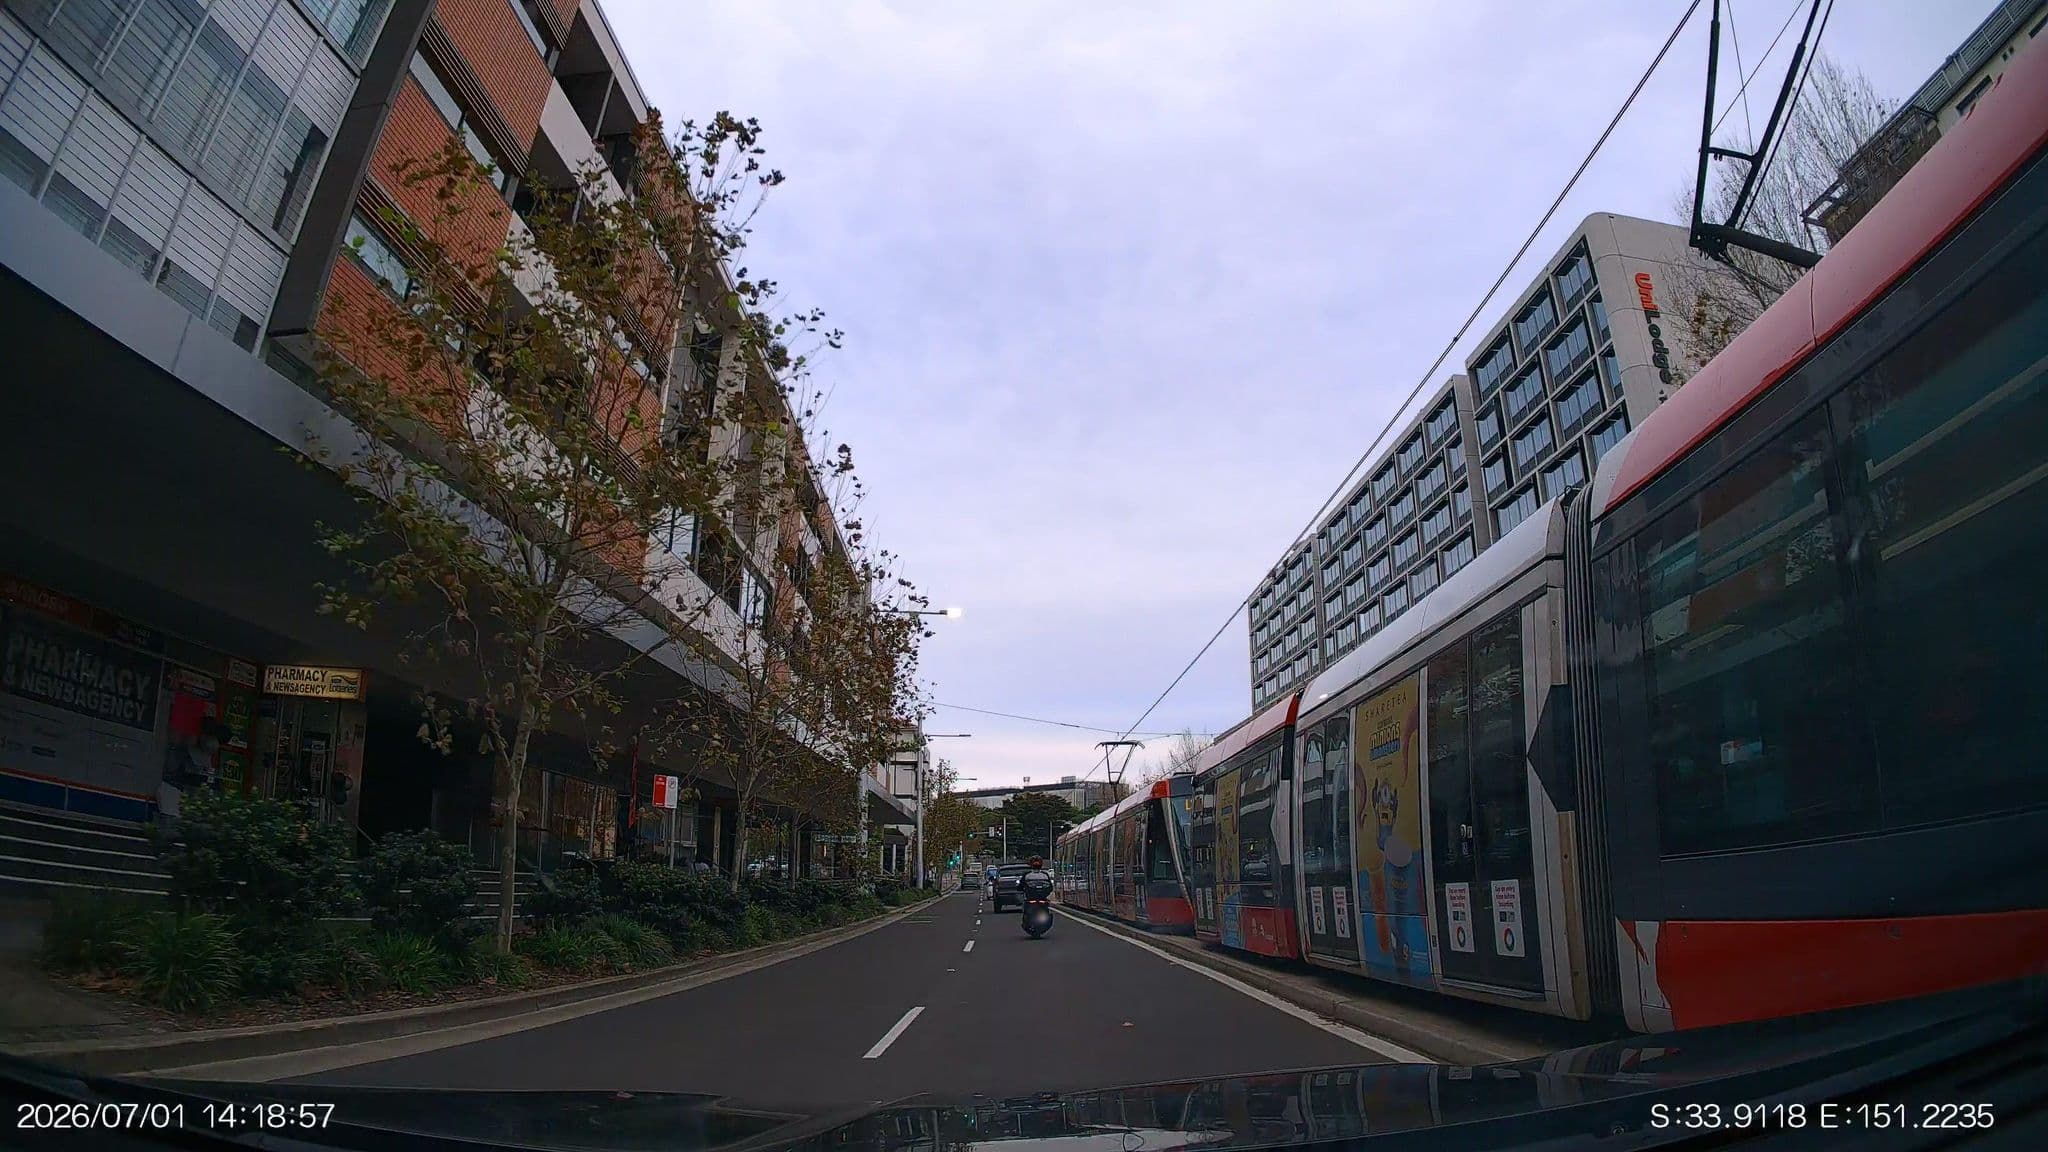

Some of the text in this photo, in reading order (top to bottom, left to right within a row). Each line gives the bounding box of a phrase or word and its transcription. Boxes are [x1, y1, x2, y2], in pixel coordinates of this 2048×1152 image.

[267, 667, 328, 682] PHARMACY
[265, 682, 327, 694] & NEWSAGENCY
